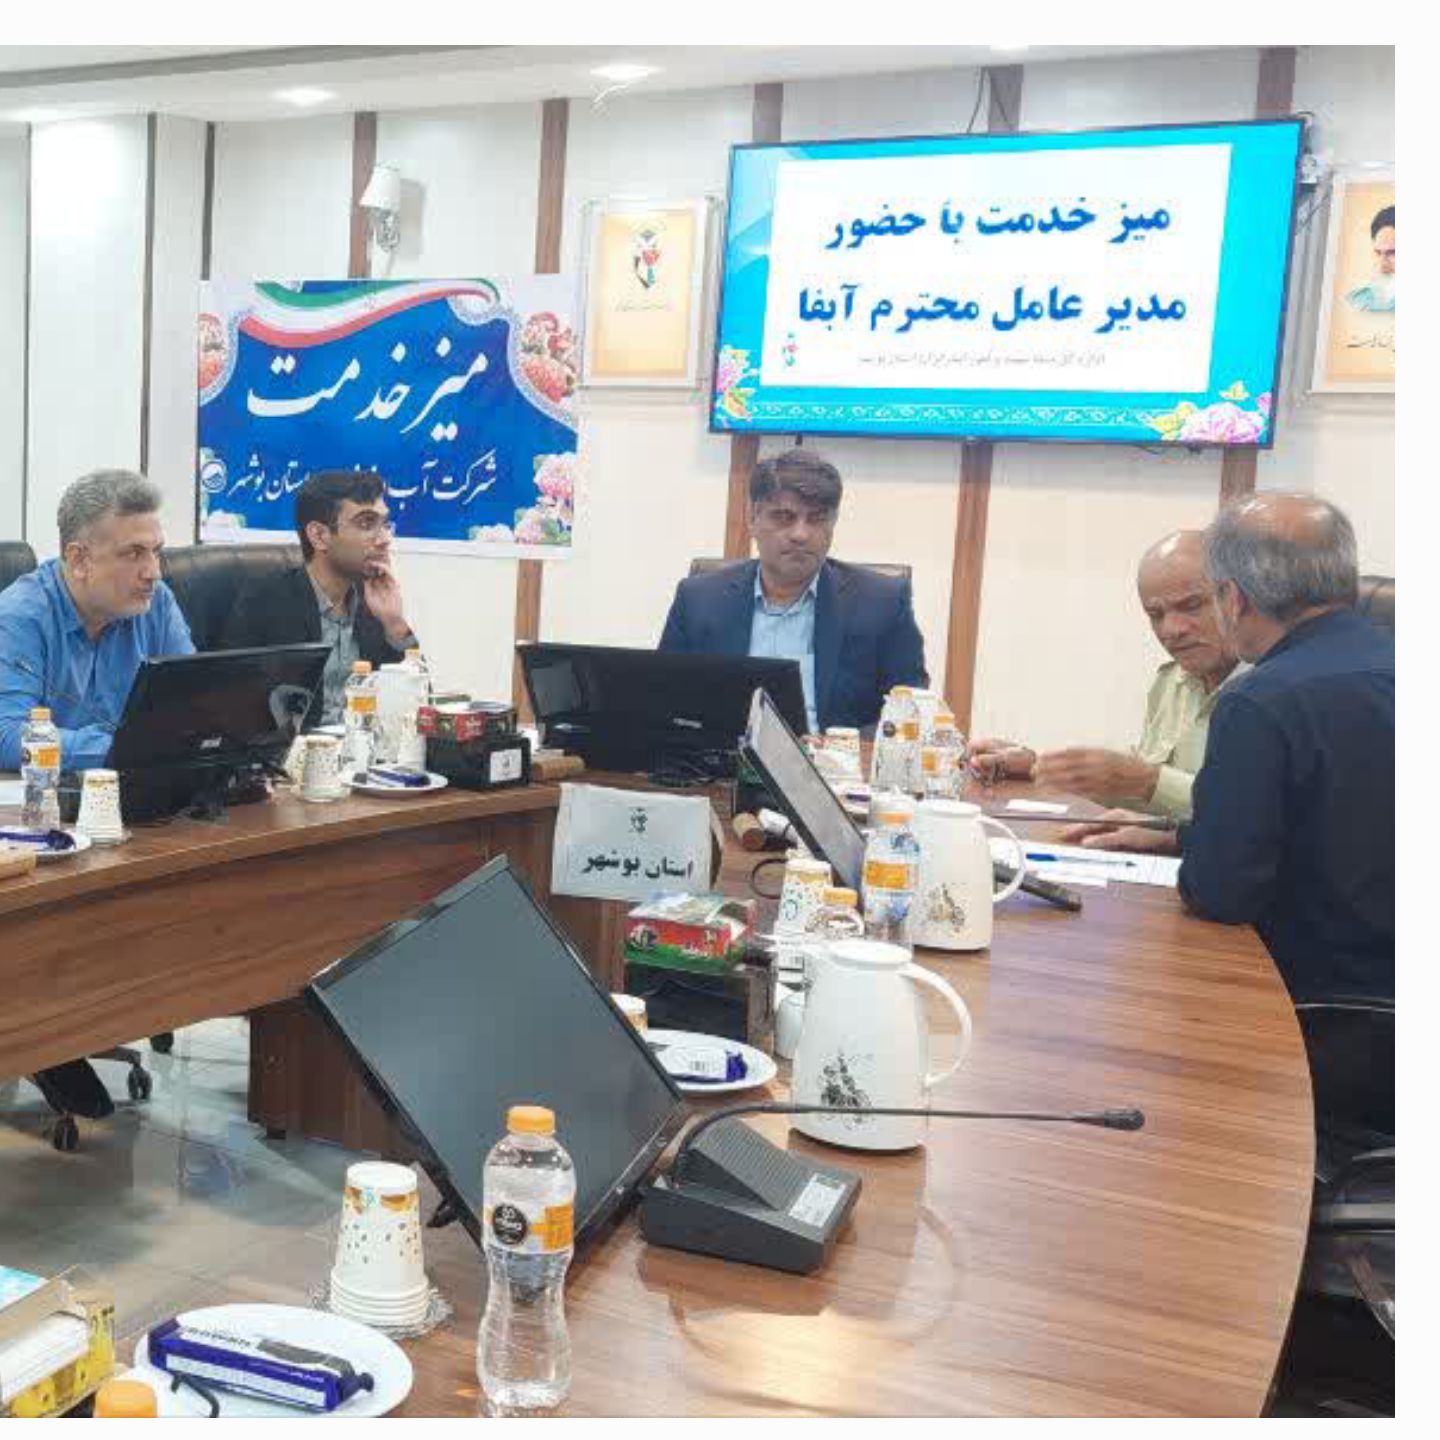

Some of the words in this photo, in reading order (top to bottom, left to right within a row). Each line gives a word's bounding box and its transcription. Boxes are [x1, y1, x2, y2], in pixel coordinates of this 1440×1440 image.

[826, 203, 927, 249] حضور
[940, 201, 965, 244] با
[976, 197, 1097, 236] خدمت
[1109, 202, 1171, 244] میز
[798, 284, 858, 330] آبفا
[870, 292, 980, 333] محترم
[992, 286, 1083, 331] عامل
[1095, 290, 1186, 334] مدیر
[247, 342, 410, 420] خدمت
[401, 337, 489, 441] میز
[227, 453, 265, 503] بوشهر
[387, 459, 439, 510] آب
[433, 449, 496, 505] شرکت
[582, 849, 641, 878] بوشهر
[645, 857, 693, 880] استان
